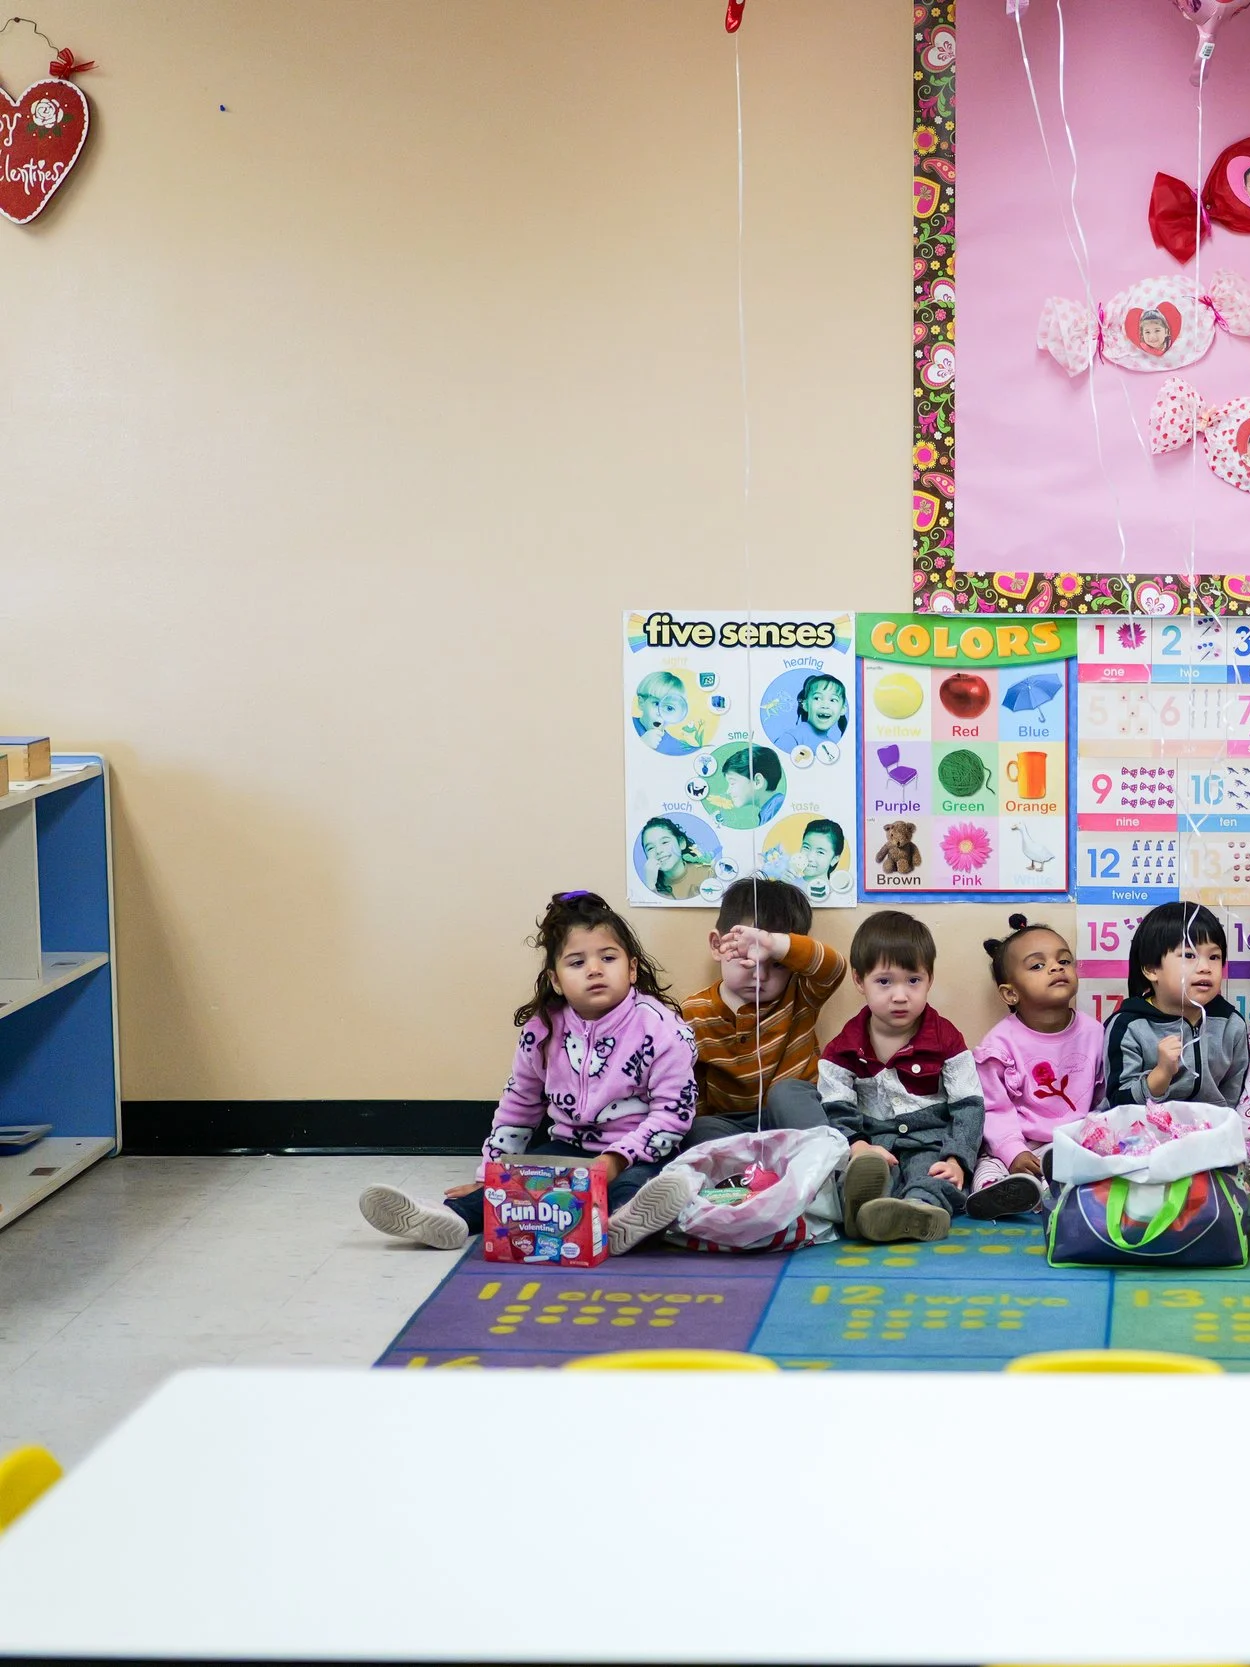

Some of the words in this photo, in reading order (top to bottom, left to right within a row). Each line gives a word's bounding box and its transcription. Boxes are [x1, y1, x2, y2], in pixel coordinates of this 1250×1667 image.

[0, 113, 22, 147] y
[645, 613, 714, 648] five
[719, 620, 837, 650] senses
[870, 621, 1062, 658] COLORS
[1095, 624, 1105, 655] 1
[1162, 625, 1182, 656] 2
[783, 656, 824, 671] hearing
[1103, 668, 1125, 677] one
[1180, 668, 1200, 678] two
[1160, 696, 1180, 726] 6
[878, 725, 922, 737] Yellow
[952, 725, 979, 738] Red
[1018, 725, 1049, 738] Blue
[1092, 774, 1112, 804] 9
[1191, 775, 1223, 804] 10
[662, 801, 692, 812] touch
[791, 802, 820, 812] taste
[875, 799, 921, 817] Purple
[942, 799, 985, 813] Green
[1005, 799, 1057, 816] Orange
[1116, 817, 1139, 827] nine
[1219, 817, 1237, 827] ten
[1087, 848, 1120, 878] 12
[876, 874, 921, 886] Brown
[952, 874, 982, 886] Pink
[1112, 890, 1148, 900] twelve
[1087, 922, 1120, 951] 15
[520, 1169, 551, 1178] Valentine
[501, 1203, 536, 1224] Fun
[539, 1202, 572, 1230] Dip
[519, 1224, 554, 1233] Valentine
[477, 1282, 541, 1300] 11
[558, 1292, 724, 1304] eleven
[810, 1285, 885, 1304] 12
[904, 1293, 1069, 1307] twelve
[1131, 1289, 1204, 1308] 13
